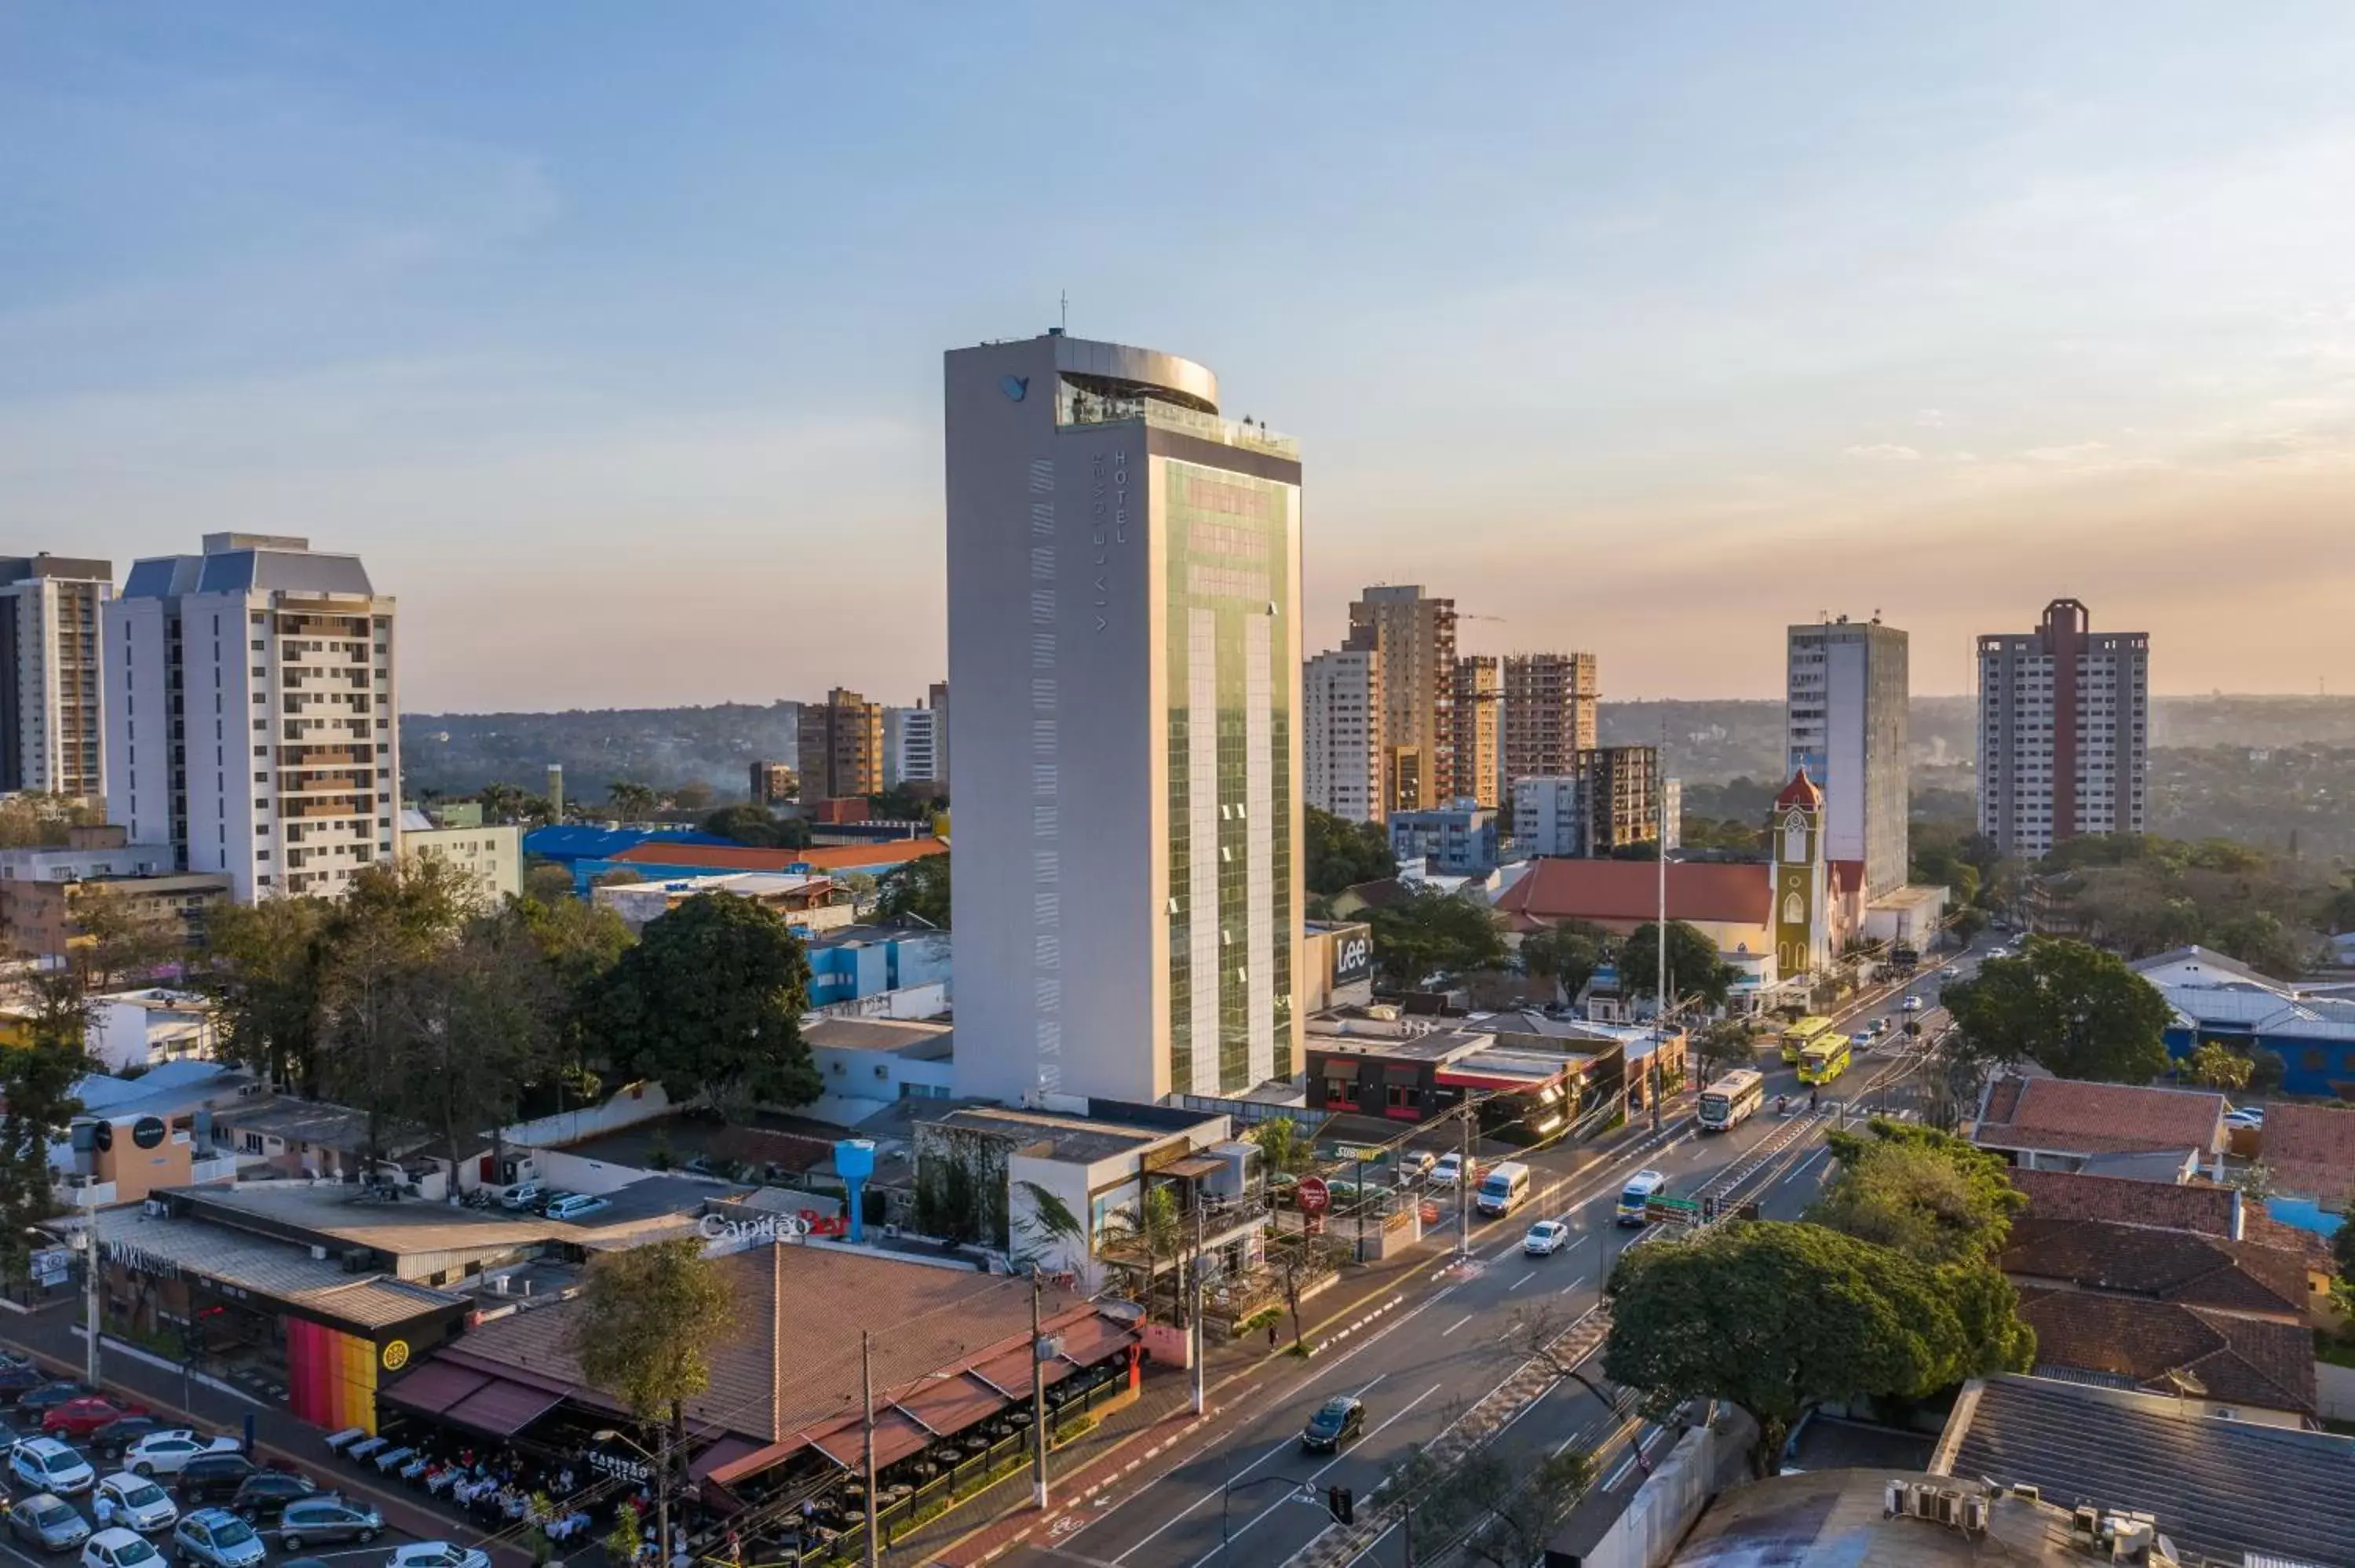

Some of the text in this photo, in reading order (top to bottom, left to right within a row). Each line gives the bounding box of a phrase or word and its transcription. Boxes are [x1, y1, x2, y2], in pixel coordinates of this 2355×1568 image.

[1115, 450, 1127, 543] HOTEL
[1094, 533, 1107, 632] VIALE
[1337, 939, 1366, 973] Lee
[1335, 1147, 1380, 1160] SUBWAY
[699, 1209, 850, 1240] Capitão Bar
[111, 1240, 175, 1278] MAKI SUSHI
